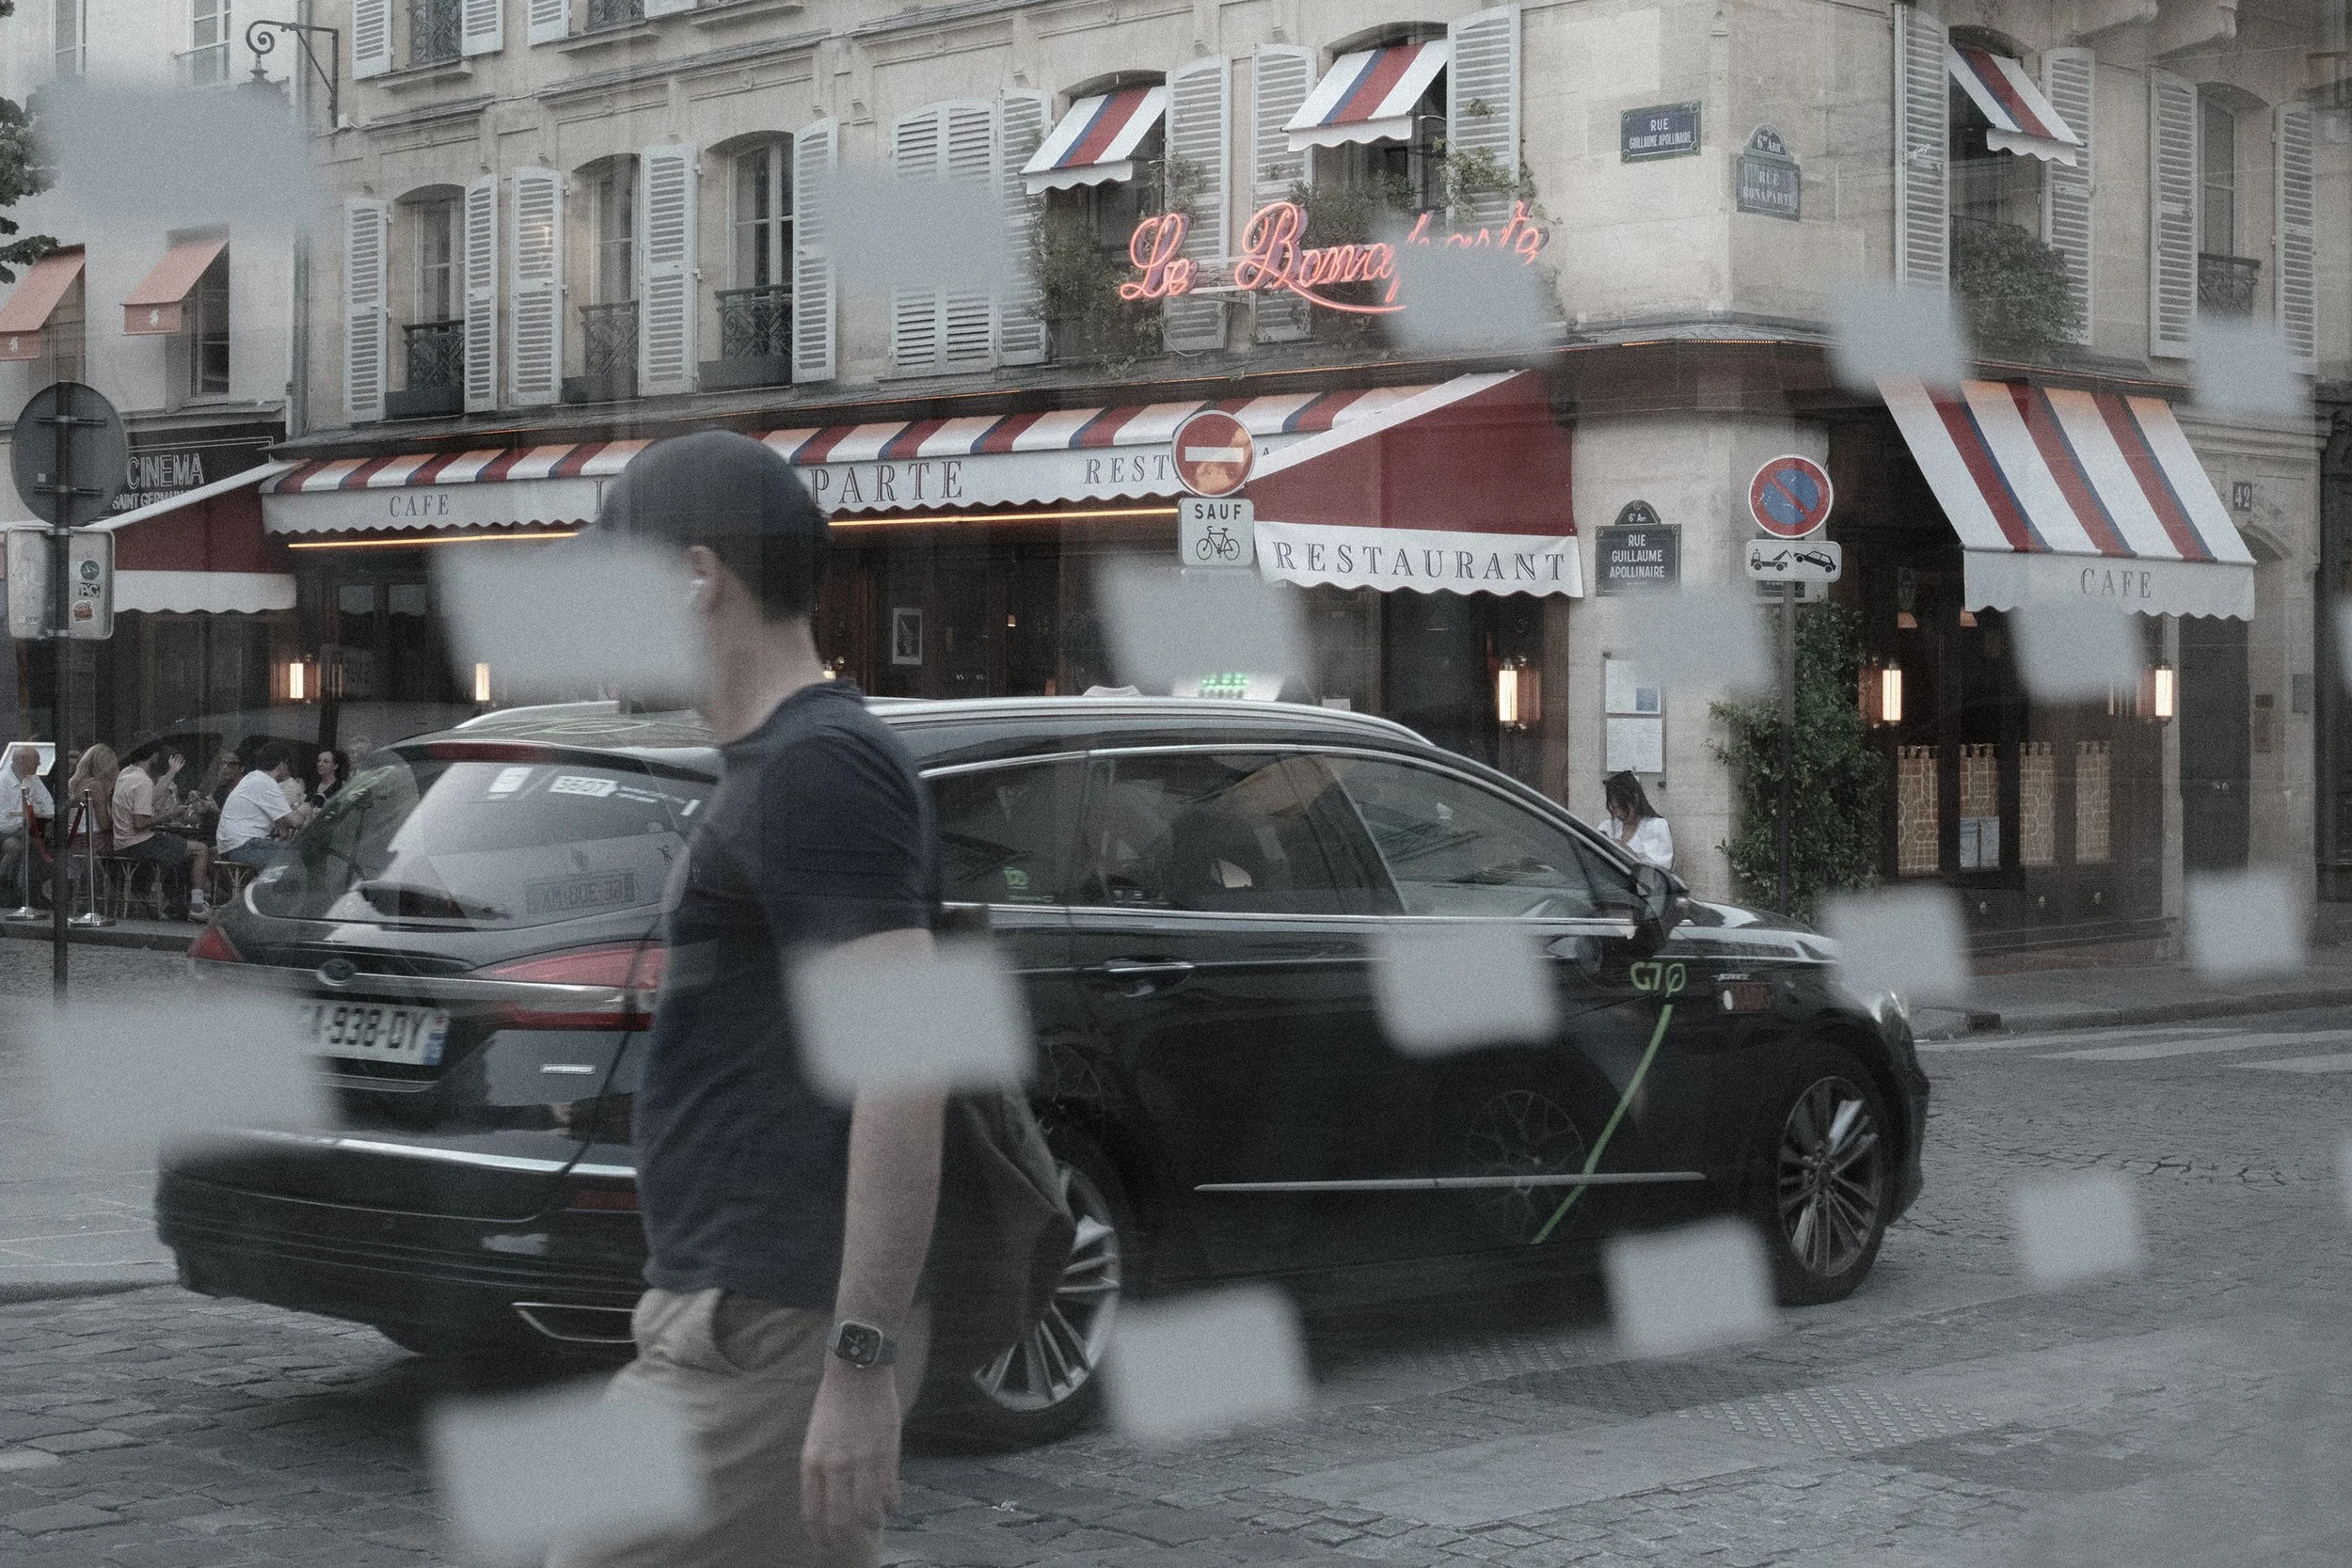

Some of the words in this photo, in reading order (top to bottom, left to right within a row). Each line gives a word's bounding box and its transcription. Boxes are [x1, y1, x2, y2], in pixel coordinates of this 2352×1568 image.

[1650, 118, 1670, 132] RUE
[1629, 135, 1659, 150] GUILLAUME
[1659, 131, 1692, 147] APOLLINAIRE
[1759, 170, 1780, 186] RUE
[1120, 212, 1200, 301] Le
[126, 452, 205, 490] CINEMA
[111, 493, 140, 511] SAINT
[389, 484, 450, 517] CAFE
[2234, 485, 2251, 508] 42
[1194, 503, 1242, 520] SAUF
[1628, 534, 1646, 547] RUE
[1272, 541, 1565, 581] RESTAURANT
[1612, 549, 1663, 563] GUILLAUME
[1609, 565, 1665, 578] APOLLINAIRE
[2080, 567, 2153, 599] CAFE
